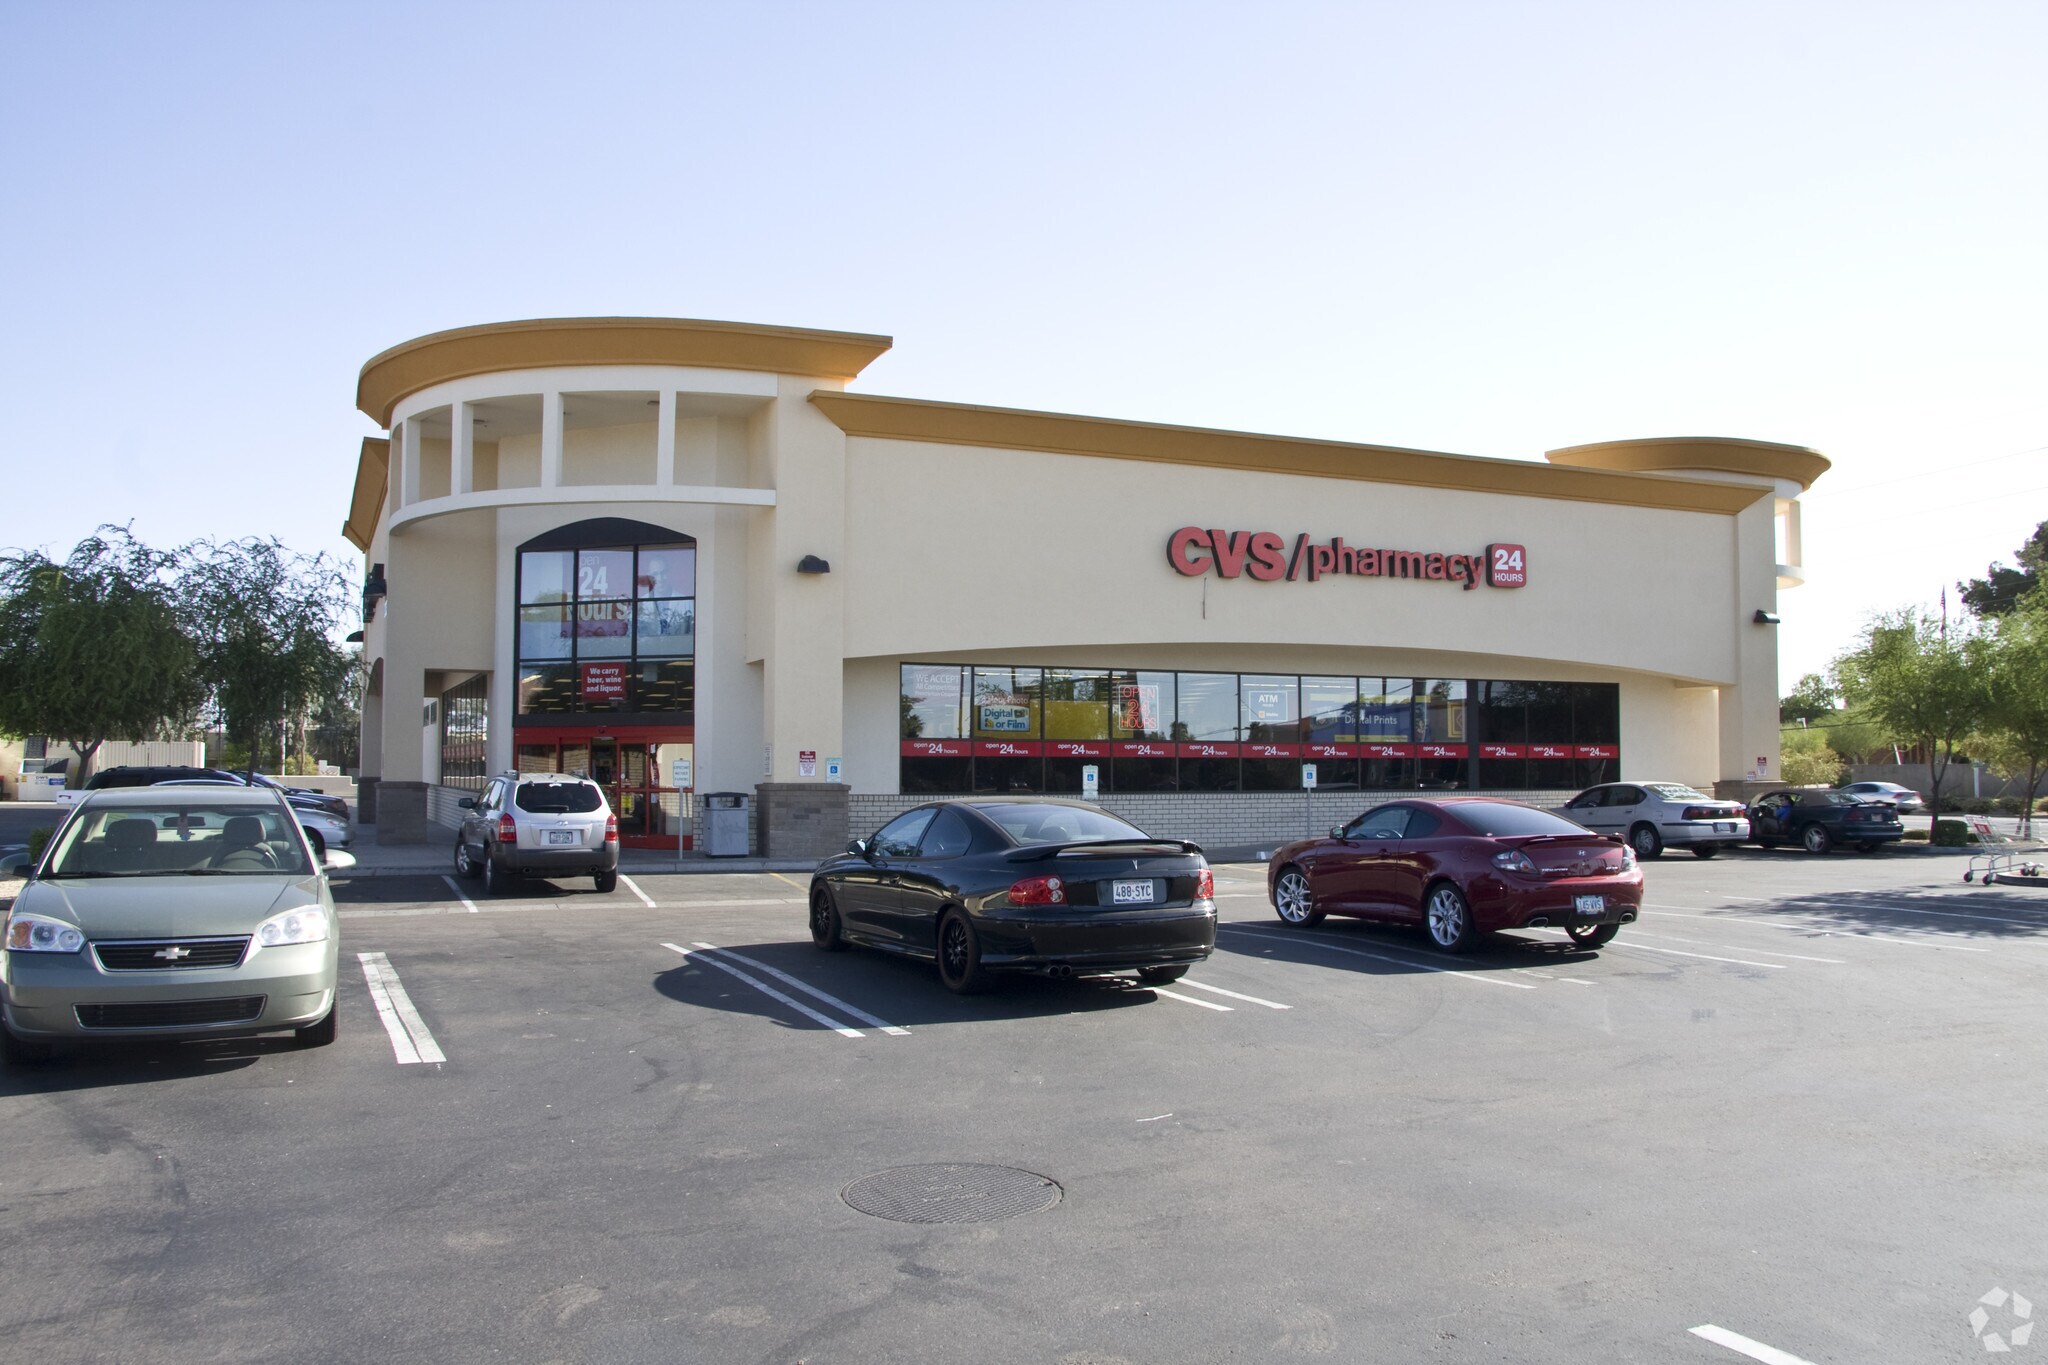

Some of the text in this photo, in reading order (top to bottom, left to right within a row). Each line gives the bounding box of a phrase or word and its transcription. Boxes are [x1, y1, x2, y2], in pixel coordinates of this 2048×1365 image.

[1495, 549, 1523, 571] 24
[579, 566, 608, 595] 24
[1494, 572, 1524, 583] HOURS
[590, 667, 620, 676] We carry
[587, 675, 622, 684] beer, wine
[930, 674, 961, 684] ACCEPT
[600, 684, 623, 693] liquor.
[1122, 686, 1156, 698] OPEN
[1258, 694, 1278, 703] ATM
[1127, 699, 1151, 717] 24
[984, 708, 1013, 719] Digital
[1007, 719, 1026, 728] Film
[1121, 717, 1157, 729] HOURS
[1373, 715, 1398, 725] Prints
[928, 743, 943, 754] 24
[1000, 743, 1014, 754] 24
[1071, 744, 1085, 754] 24
[1137, 745, 1151, 755] 24
[1202, 745, 1214, 755] 24
[1264, 746, 1277, 756] 24
[1324, 746, 1336, 756] 24
[1382, 746, 1393, 756] 24
[1434, 747, 1445, 756] 24
[1496, 747, 1506, 756] 24
[1543, 747, 1554, 756] 24
[1589, 747, 1600, 756] 24
